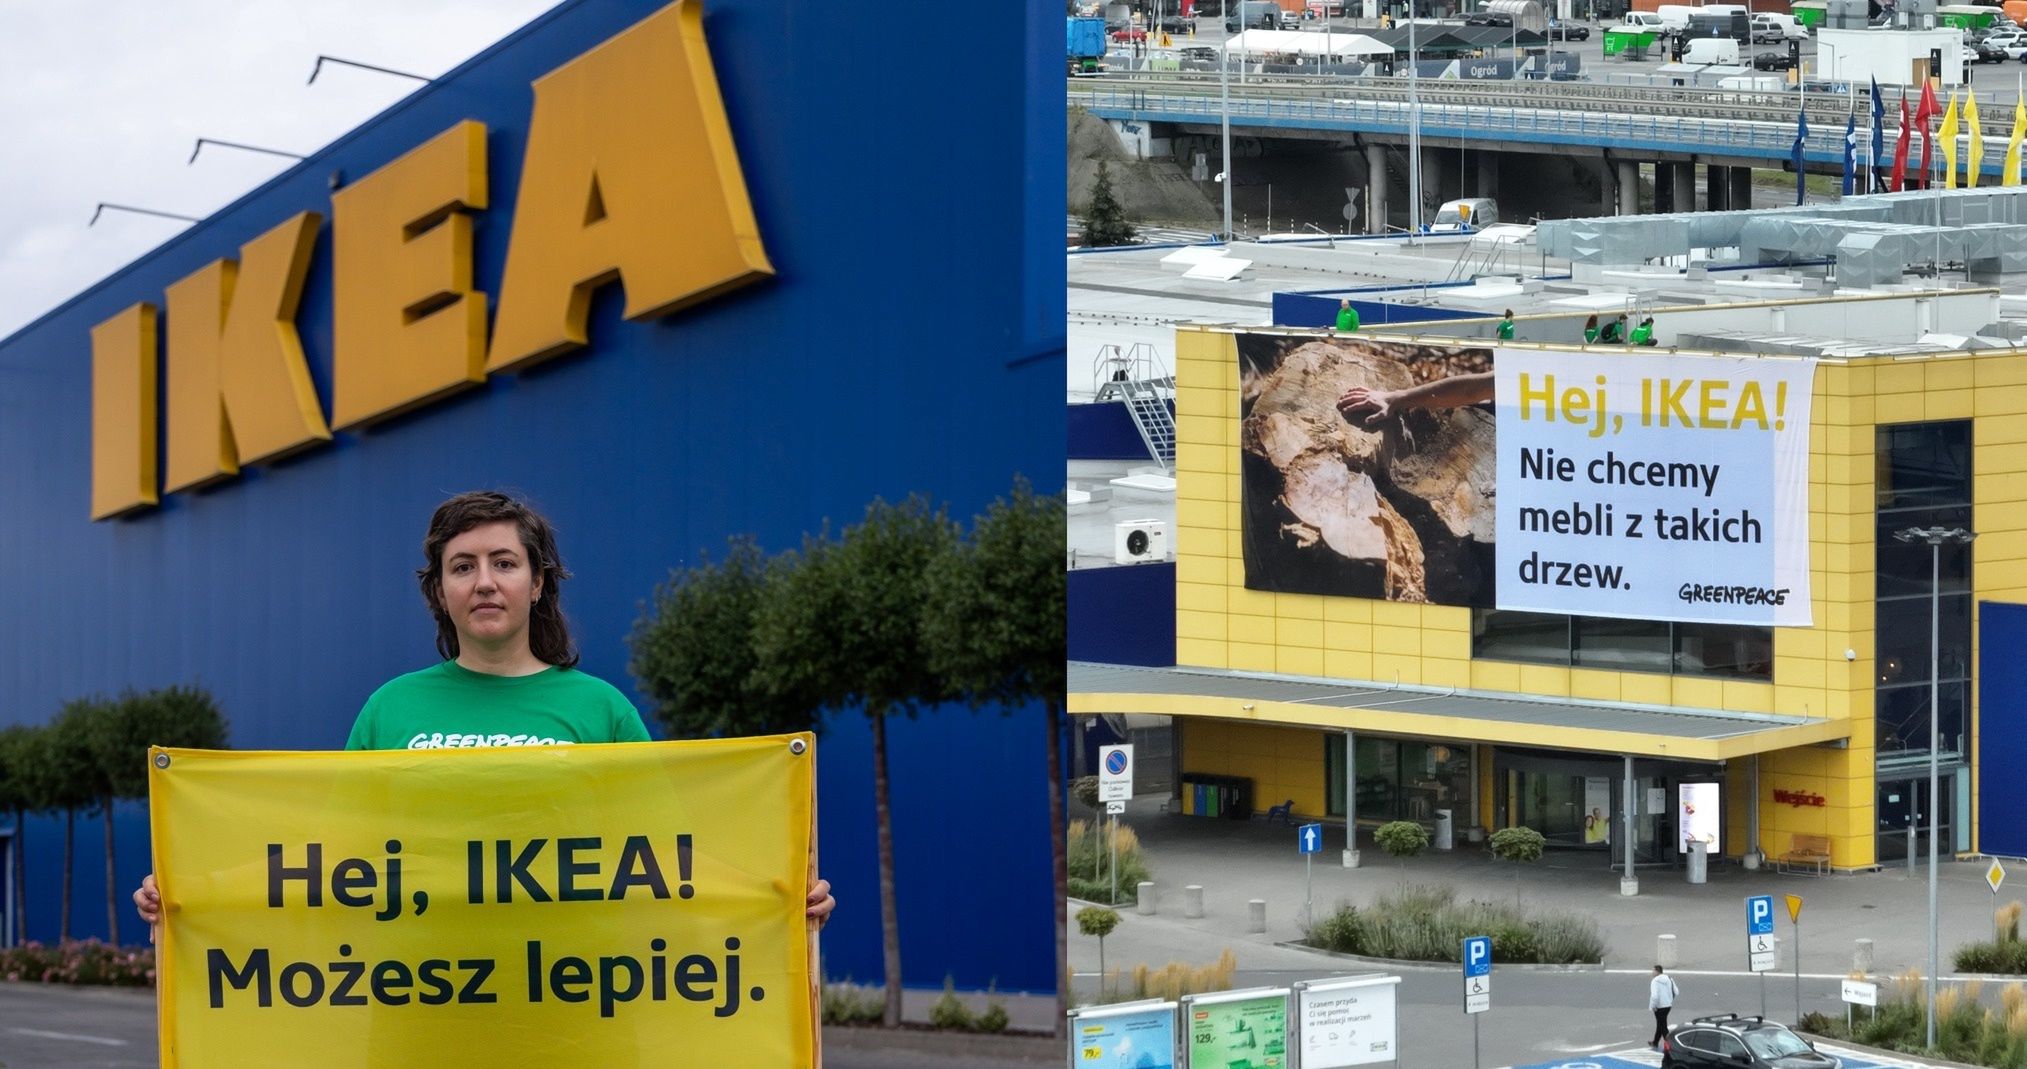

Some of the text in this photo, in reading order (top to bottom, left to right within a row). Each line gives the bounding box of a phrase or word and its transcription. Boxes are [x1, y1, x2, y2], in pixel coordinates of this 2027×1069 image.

[1471, 65, 1498, 79] Ogród
[92, 0, 775, 522] IKEA
[1519, 373, 1789, 438] Hej, IKEA!
[1520, 447, 1720, 497] Nie chcemy
[1520, 500, 1762, 544] mebli z takich
[1519, 551, 1632, 591] drzew.
[1678, 582, 1791, 606] GREENPEACE
[1773, 789, 1826, 808] Wejście
[266, 833, 695, 921] Hej, IKEA!
[1753, 900, 1769, 924] P
[1471, 940, 1485, 966] P
[206, 936, 766, 1018] Możesz lepiej.
[1309, 1000, 1334, 1009] Czasem
[1195, 1033, 1216, 1044] 129,-
